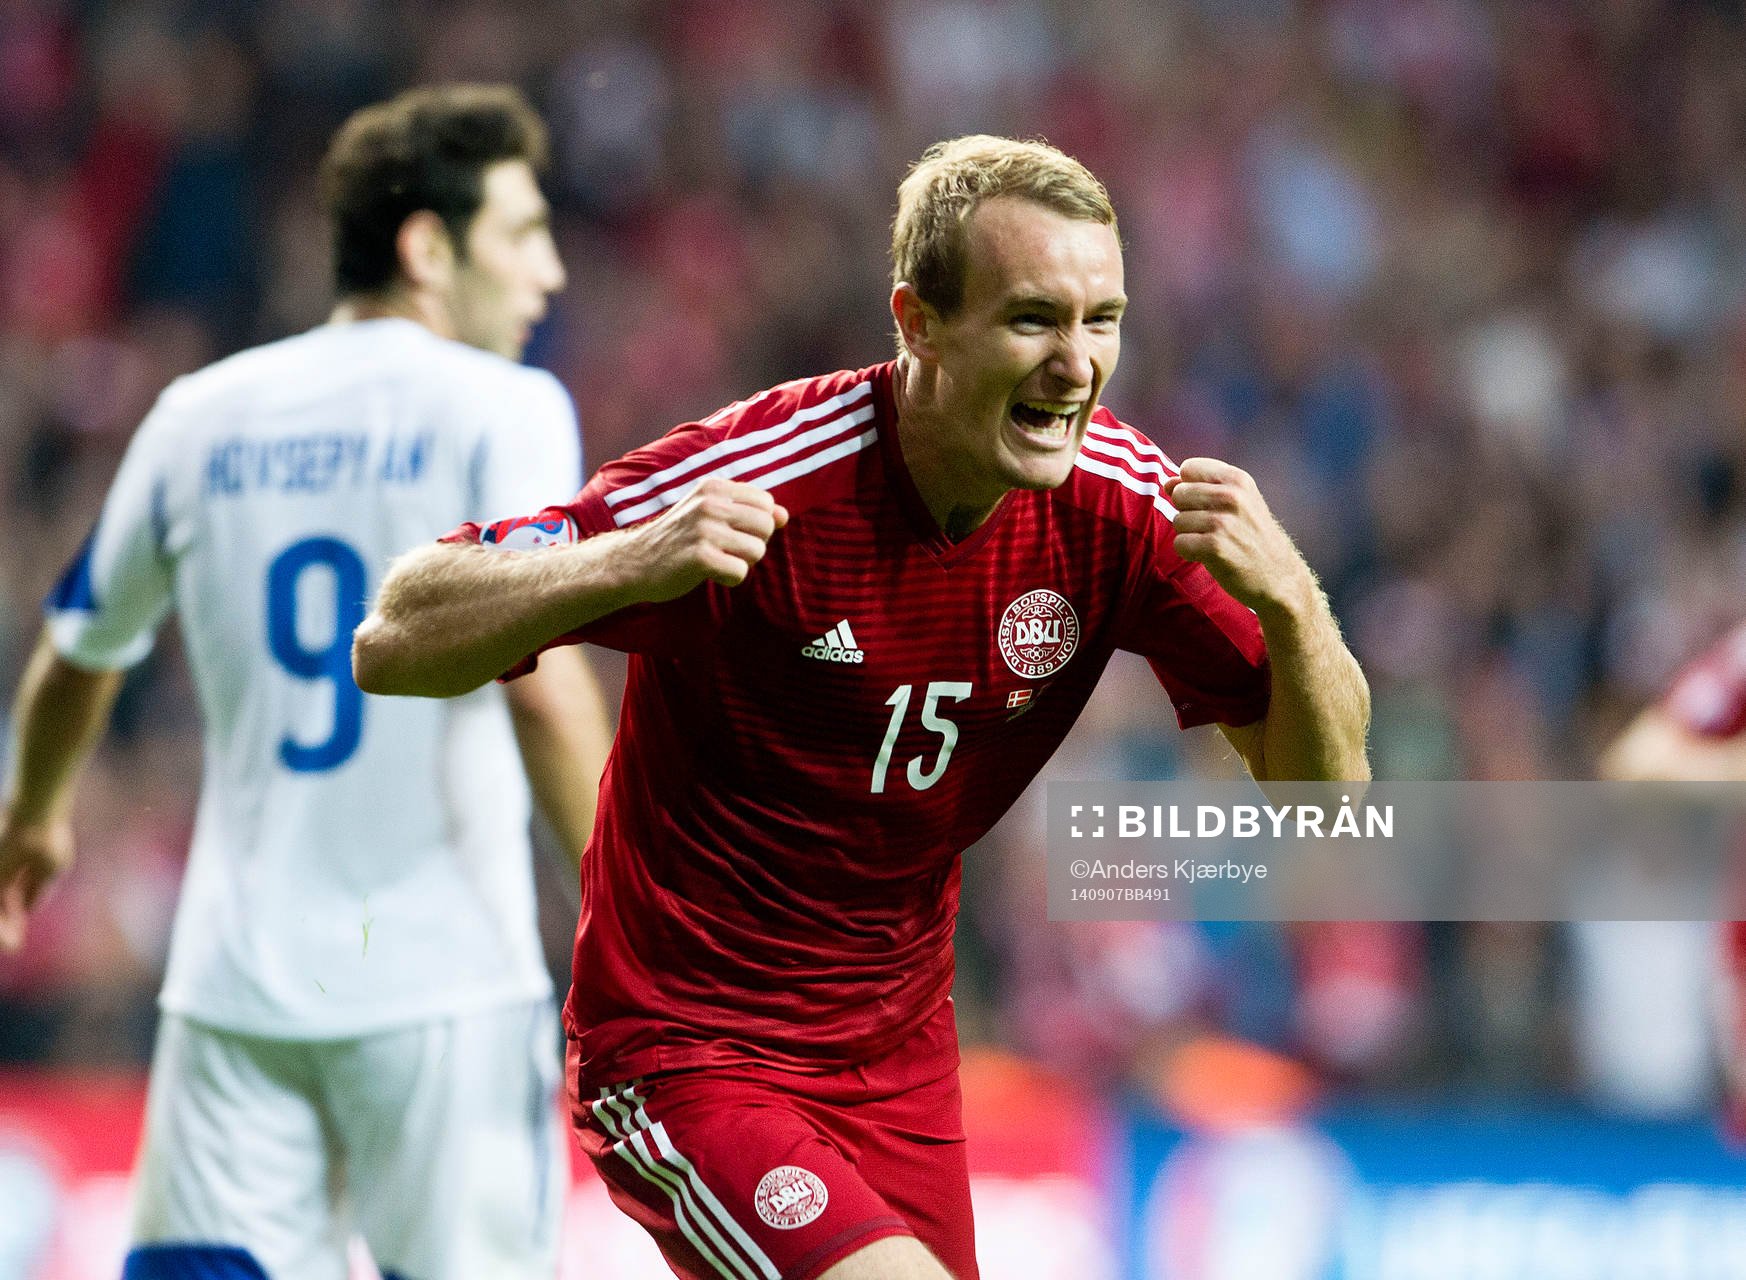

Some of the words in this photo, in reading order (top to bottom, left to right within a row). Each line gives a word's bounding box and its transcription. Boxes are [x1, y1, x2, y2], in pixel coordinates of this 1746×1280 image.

[1001, 616, 1021, 667] DANSK
[1014, 618, 1061, 645] DBU
[266, 534, 368, 773] 9
[801, 646, 864, 664] adidas
[1022, 661, 1054, 675] 1889
[870, 681, 973, 793] 15
[769, 1180, 813, 1213] DBU
